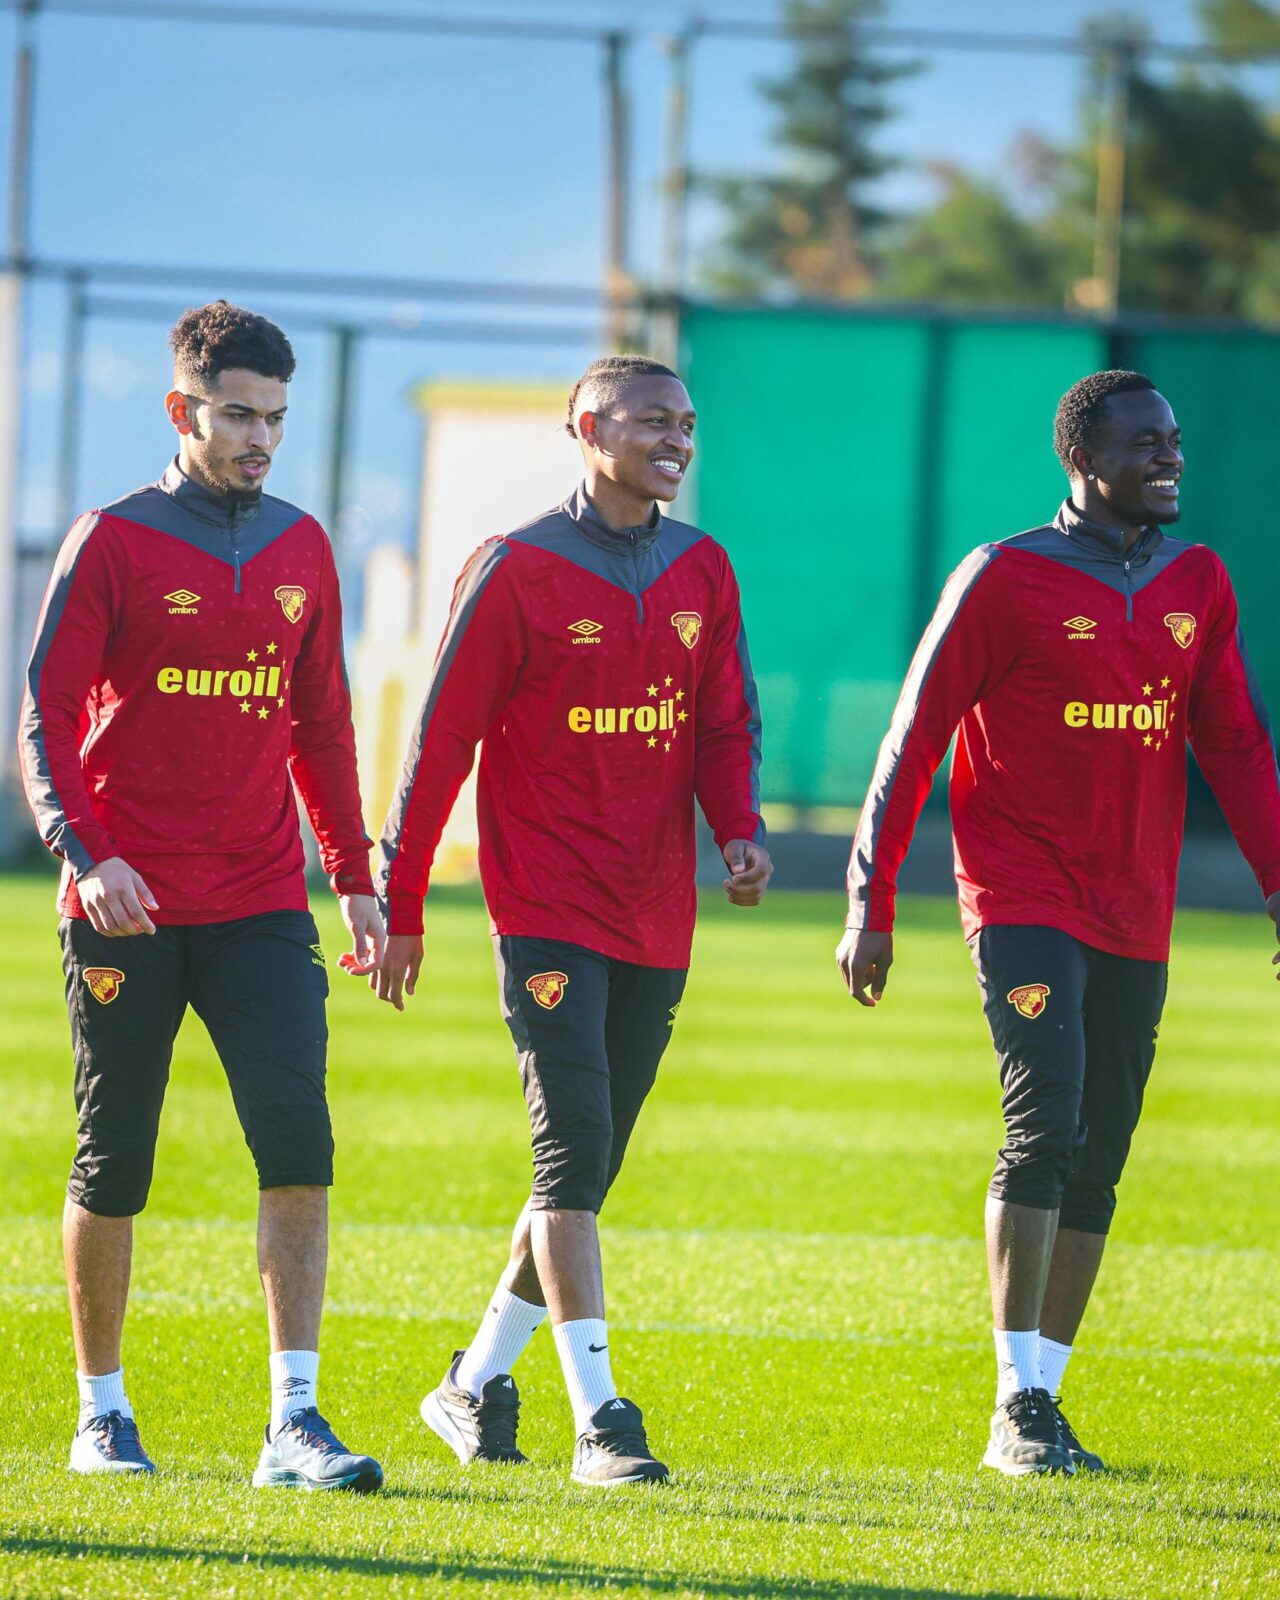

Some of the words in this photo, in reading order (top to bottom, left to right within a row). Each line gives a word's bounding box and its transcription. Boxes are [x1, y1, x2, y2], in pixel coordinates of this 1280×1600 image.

[168, 605, 199, 615] umbro
[572, 635, 601, 645] umbro
[1068, 631, 1096, 640] umbro
[156, 665, 281, 697] euroil
[567, 698, 674, 734] euroil
[1064, 699, 1169, 731] euroil
